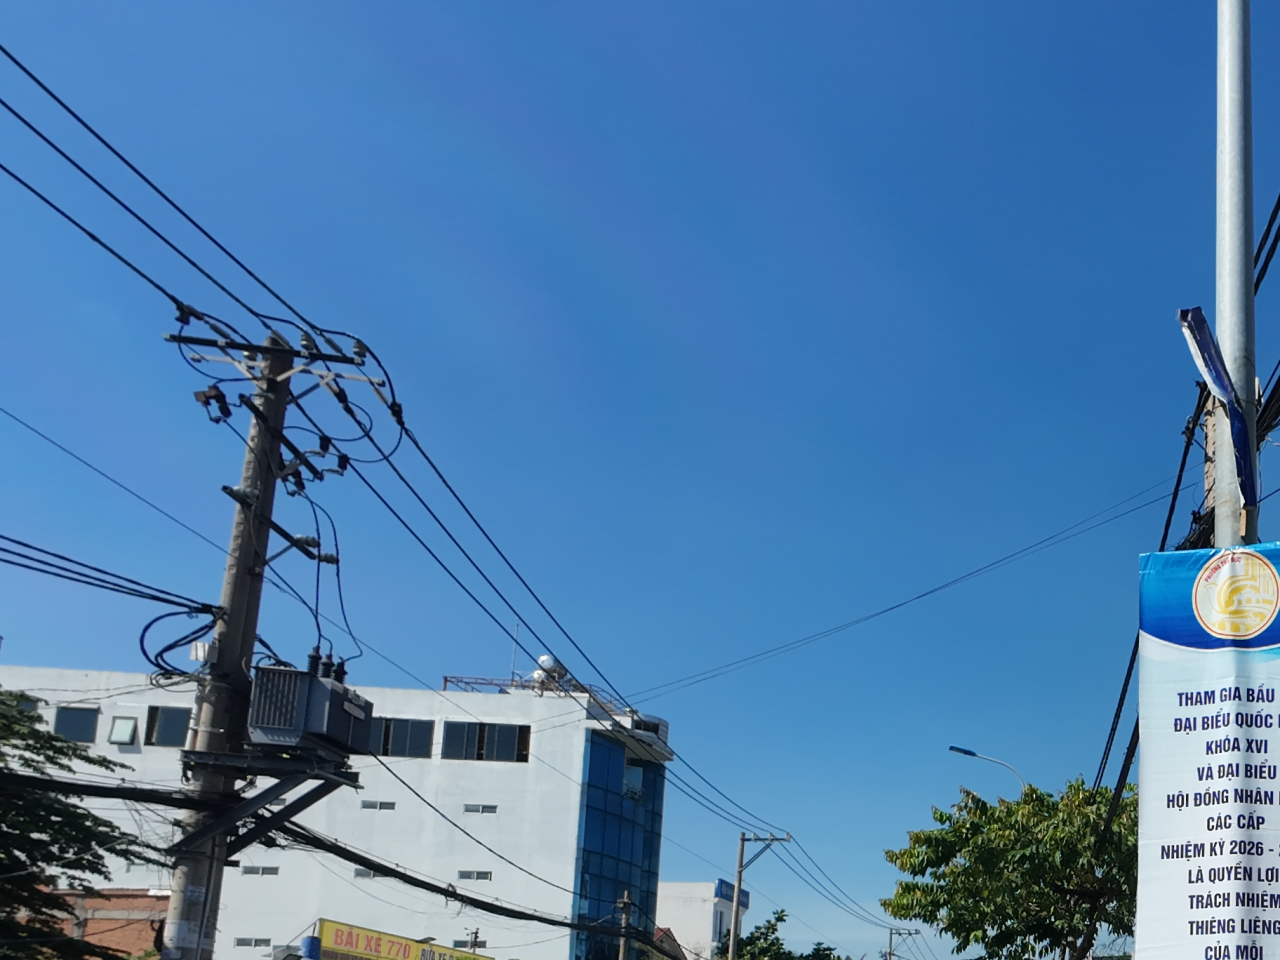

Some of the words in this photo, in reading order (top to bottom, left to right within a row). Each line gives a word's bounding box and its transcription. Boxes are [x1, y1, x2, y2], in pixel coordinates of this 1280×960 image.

[1177, 690, 1216, 707] THAM
[1220, 687, 1242, 702] GIA
[1246, 683, 1275, 703] BẦU
[1174, 717, 1197, 735] ĐẠI
[1201, 708, 1231, 731] BIỂU
[1235, 709, 1273, 729] QUỐC
[1205, 735, 1240, 756] KHÓA
[1245, 738, 1268, 754] XVI
[1197, 762, 1214, 781] VÀ
[1218, 763, 1240, 781] ĐẠI
[1244, 759, 1277, 780] BIỂU
[1166, 791, 1189, 811] HỘI
[1193, 787, 1229, 807] ĐỒNG
[1234, 787, 1274, 806] NHÂN
[1207, 812, 1232, 831] CÁC
[1237, 810, 1265, 830] CẤP
[1161, 841, 1205, 862] NHIỆM
[1209, 838, 1225, 857] KỲ
[1230, 840, 1264, 856] 2026
[1188, 866, 1204, 884] LÀ
[1208, 861, 1253, 884] QUYỀN
[1188, 891, 1231, 909] TRÁCH
[1188, 917, 1235, 935] THIÊNG
[334, 927, 360, 949] BÃI
[364, 935, 382, 954] XE
[387, 940, 411, 959] 770
[1204, 940, 1231, 960] CỦA
[1235, 940, 1263, 960] MỖI
